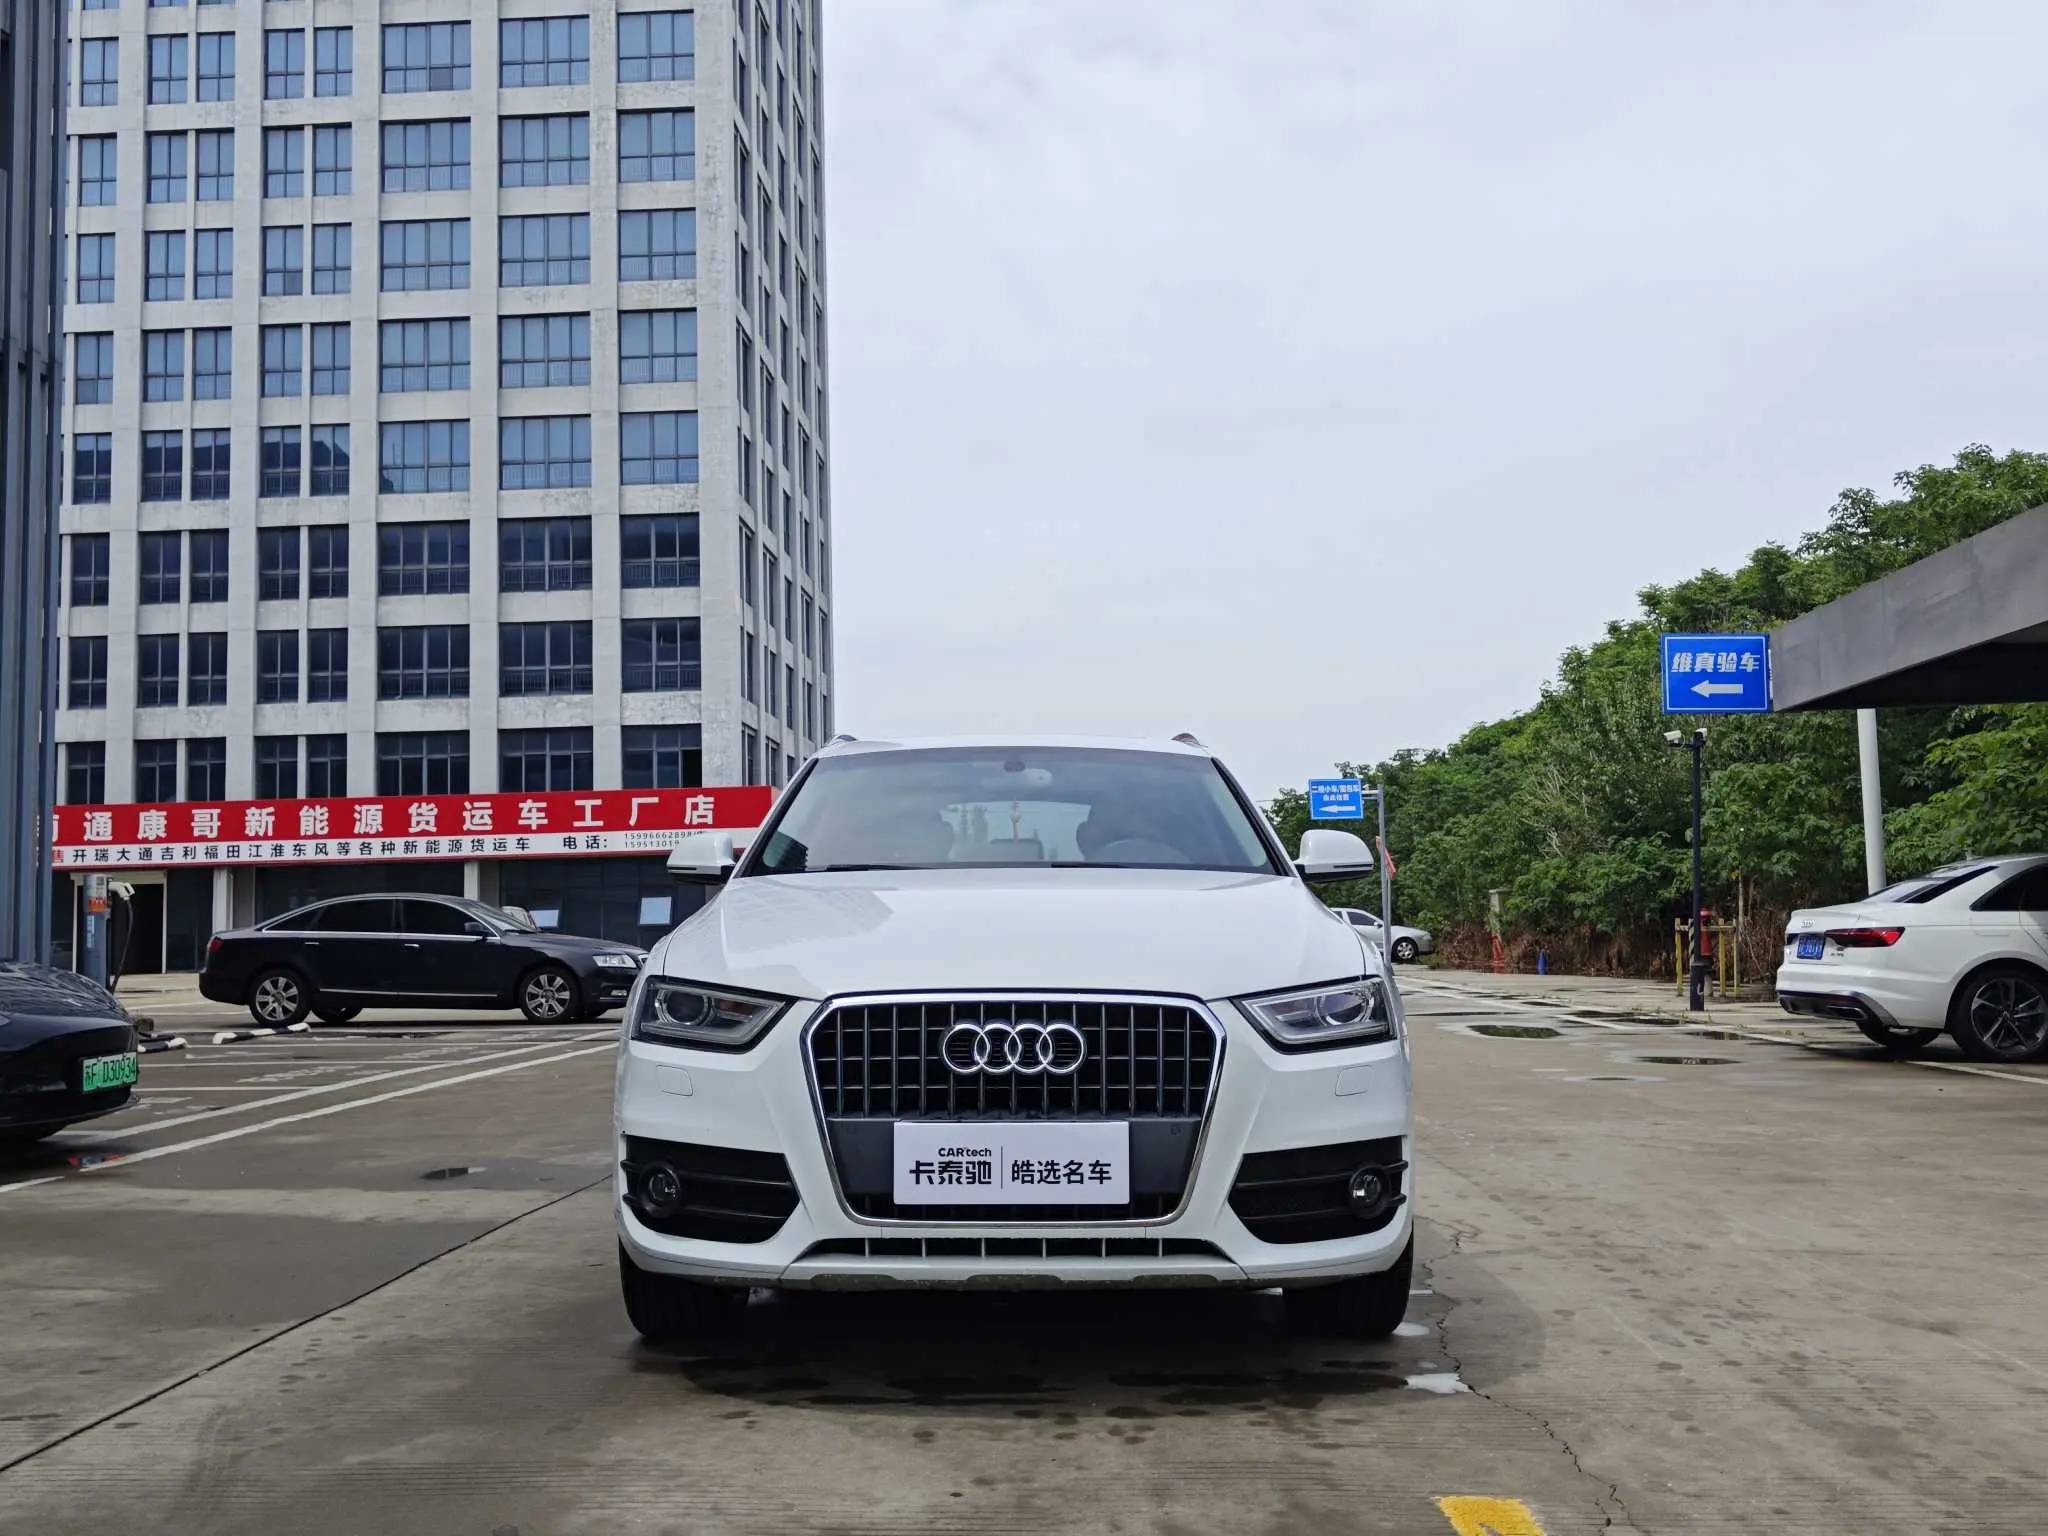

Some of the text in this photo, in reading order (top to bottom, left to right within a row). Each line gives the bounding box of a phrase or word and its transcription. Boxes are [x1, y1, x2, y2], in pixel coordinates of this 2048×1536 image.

[1671, 652, 1760, 673] 维真验车
[52, 794, 715, 842] 通康哥新能源货运车工厂店
[909, 1160, 1112, 1185] 卡泰驰 皓选名车
